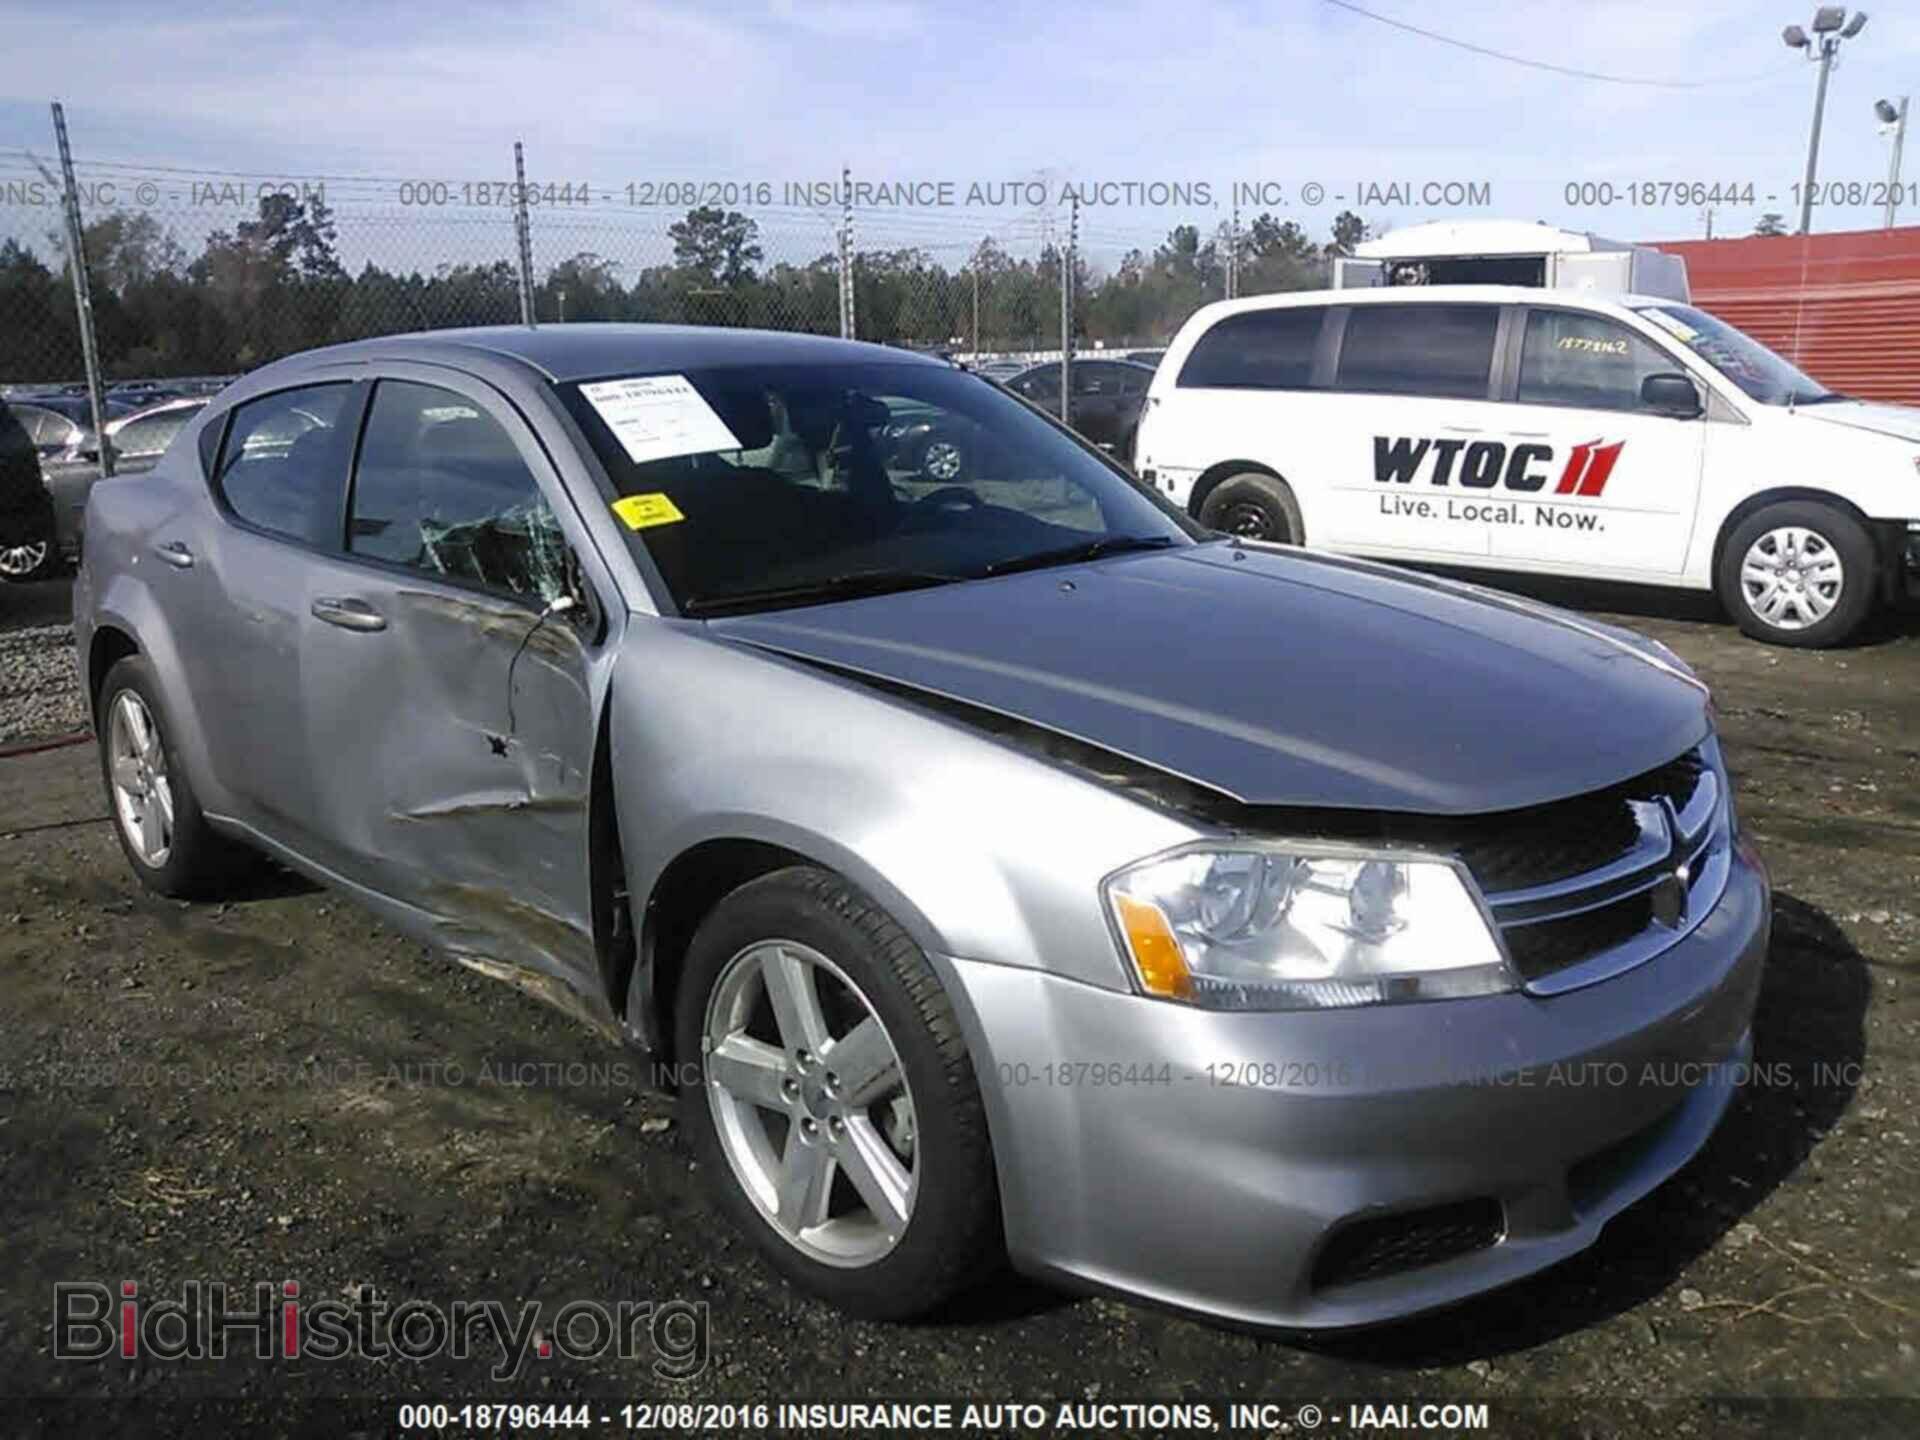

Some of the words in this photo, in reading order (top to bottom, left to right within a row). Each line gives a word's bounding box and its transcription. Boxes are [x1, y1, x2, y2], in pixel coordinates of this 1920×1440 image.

[1372, 435, 1554, 493] WTOC
[1380, 495, 1438, 519] Live.
[1447, 499, 1525, 525] Local.
[1535, 505, 1605, 531] Now.
